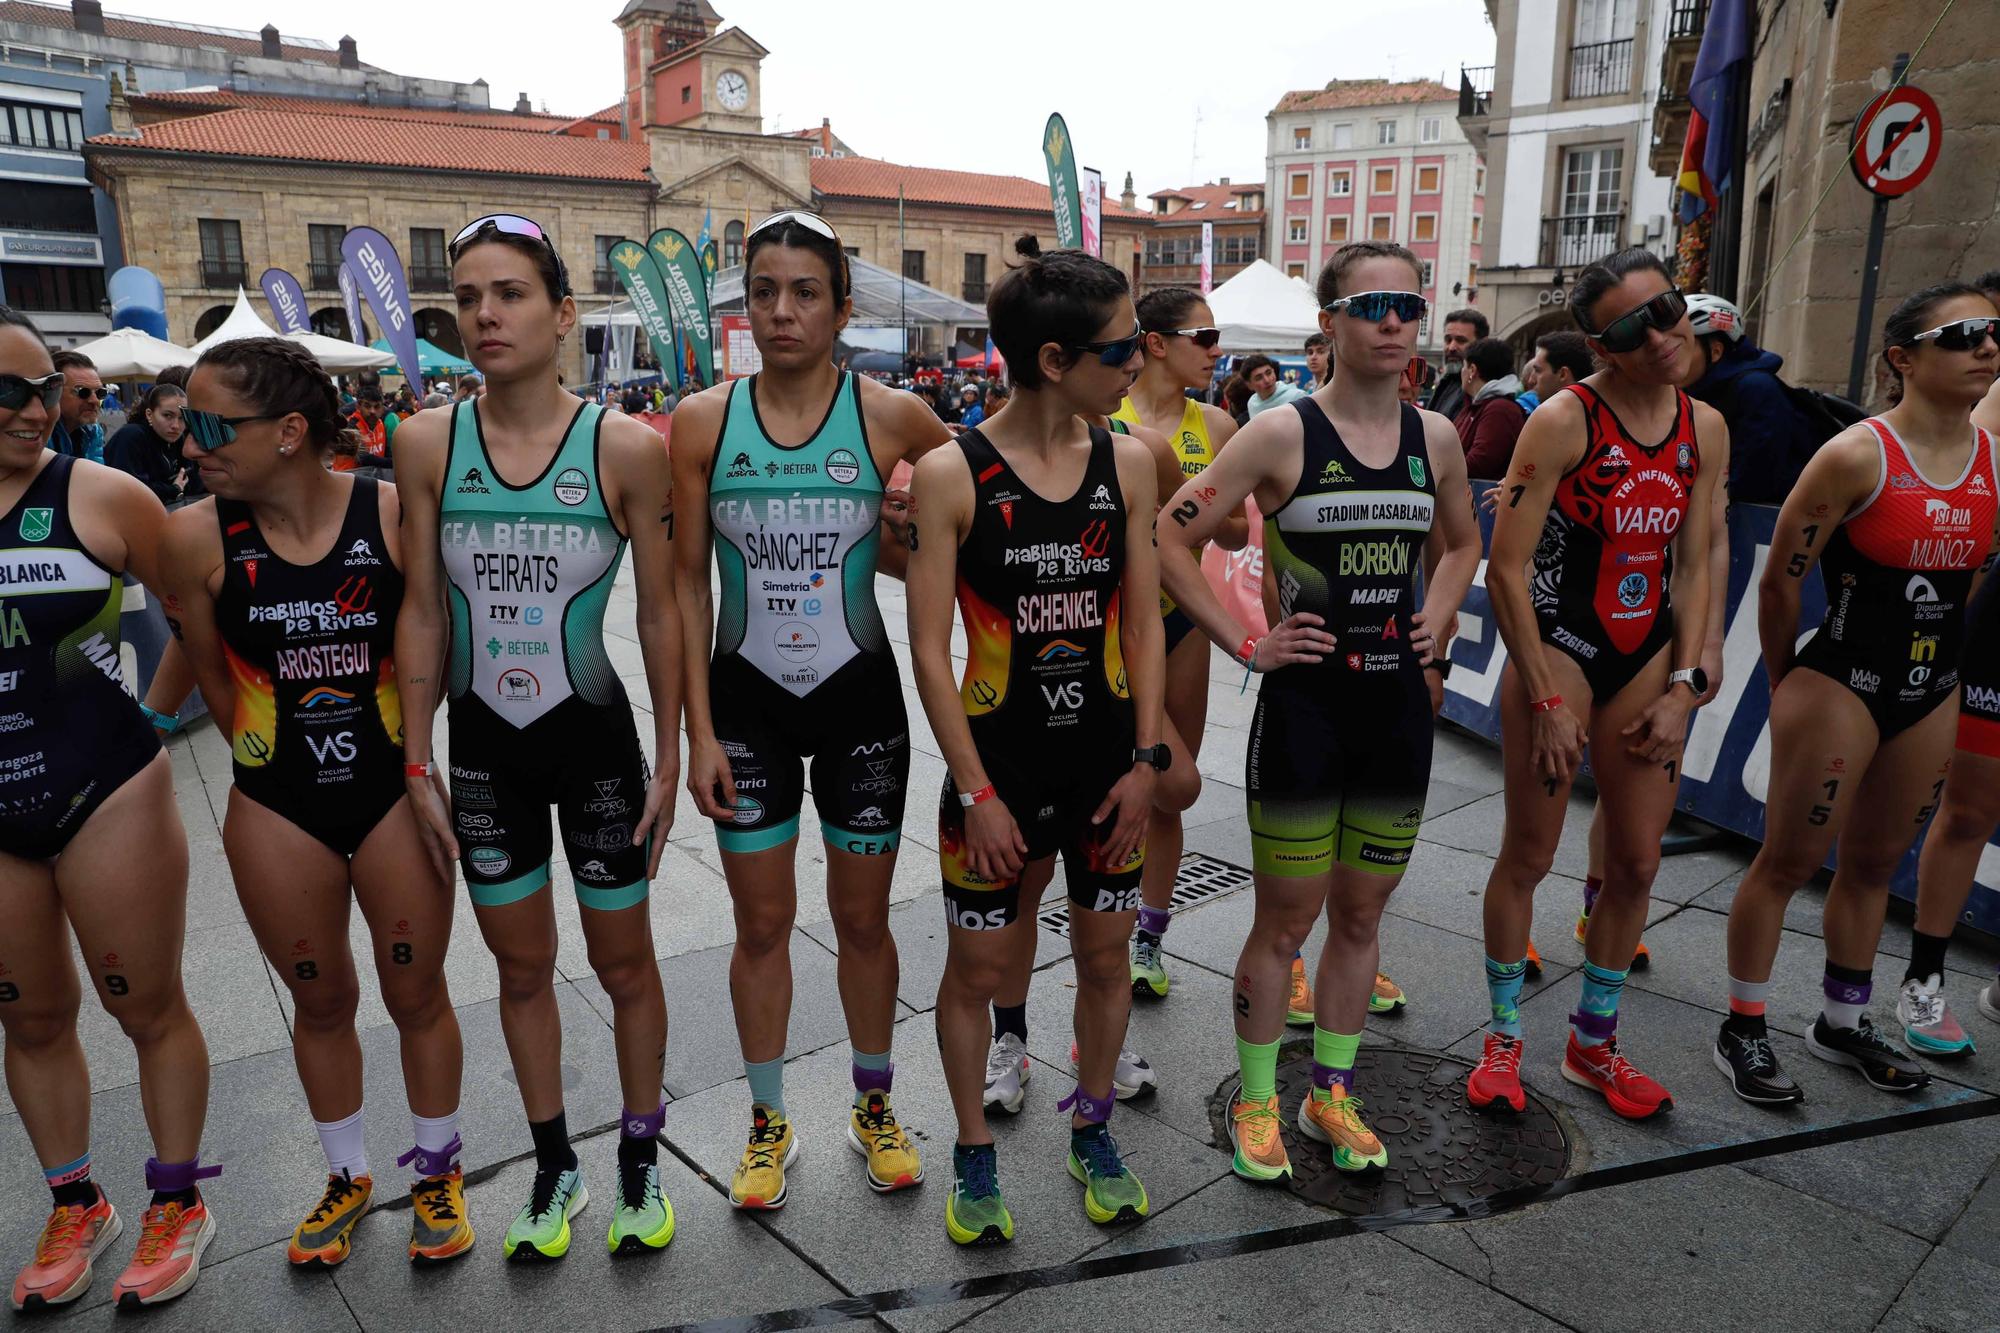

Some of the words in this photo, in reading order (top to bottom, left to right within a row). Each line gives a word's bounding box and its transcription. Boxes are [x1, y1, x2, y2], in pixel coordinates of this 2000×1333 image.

[783, 463, 818, 475] BÉTERA
[1615, 480, 1635, 499] TRI
[1638, 469, 1683, 499] INFINITY
[1510, 484, 1527, 509] 1
[715, 498, 757, 525] CEA
[767, 492, 872, 526] BÉTERA
[1171, 500, 1199, 528] 2
[1317, 504, 1369, 523] STADIUM
[1372, 504, 1431, 522] CASABLANCA
[1615, 507, 1681, 534] VARO
[443, 522, 482, 549] CEA
[493, 516, 600, 552] BÉTERA
[907, 522, 918, 551] 3
[746, 525, 840, 571] SÁNCHEZ
[1339, 535, 1411, 576] BORBÓN
[1627, 553, 1658, 562] Móstoles
[1908, 534, 1976, 568] MUÑOZ
[473, 553, 559, 593] PEIRATS
[762, 580, 810, 592] Simetria
[767, 598, 796, 611] ITV
[1350, 588, 1400, 604] MAPEI
[489, 605, 519, 620] ITV
[1016, 590, 1102, 634] SCHENKEL
[1836, 588, 1850, 641] deporama
[1926, 611, 1944, 619] Soria
[508, 639, 550, 656] BÉTERA
[1551, 626, 1598, 660] 226ERS
[277, 642, 370, 680] AROSTEGUI
[1031, 662, 1062, 671] Animación
[1066, 660, 1090, 668] Aventura
[1365, 653, 1400, 663] Zaragoza
[1851, 668, 1880, 685] MAD
[1966, 684, 2000, 704] MA
[293, 710, 329, 719] Animación
[333, 706, 362, 716] Aventura
[1049, 713, 1077, 721] CYCLING
[1047, 719, 1079, 727] BOUTIQUE
[318, 767, 351, 776] CYCLING
[1250, 738, 1261, 790] CASABLANCA
[1663, 760, 1676, 783] 1
[317, 774, 354, 783] BOUTIQUE
[584, 799, 625, 812] LYOPRO
[461, 815, 488, 824] OCHO
[847, 841, 891, 855] CEA
[393, 943, 412, 964] 8
[296, 961, 318, 979] 8
[105, 975, 128, 995] 9
[1236, 992, 1250, 1018] 2
